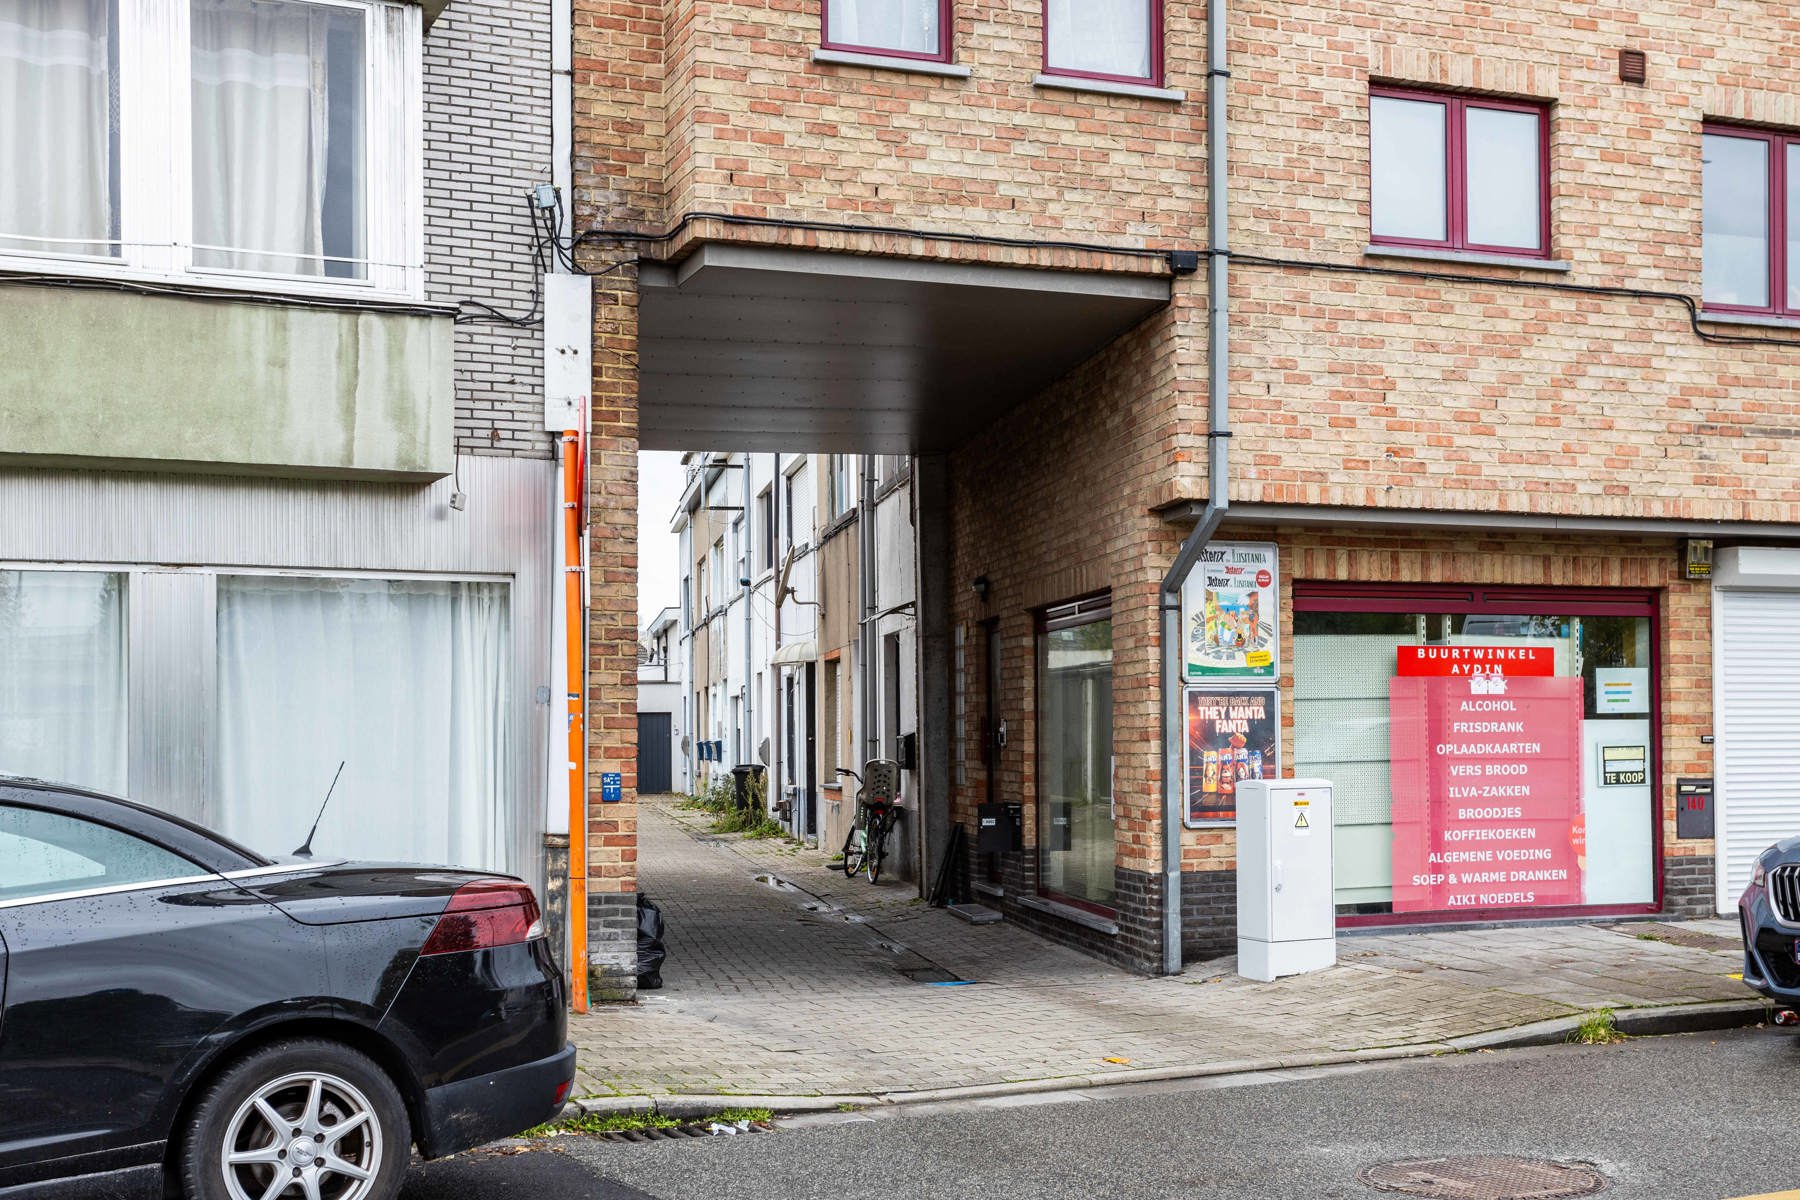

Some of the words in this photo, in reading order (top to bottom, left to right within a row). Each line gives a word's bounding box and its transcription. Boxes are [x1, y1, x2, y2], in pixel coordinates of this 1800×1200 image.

[1417, 648, 1536, 660] BUURTWINKEL
[1451, 664, 1503, 674] AYDIN
[1198, 706, 1228, 719] THEY
[1228, 706, 1266, 719] WANTA
[1460, 700, 1517, 712] ALCOHOL
[1215, 720, 1250, 733] FANTA
[1453, 721, 1524, 733] FRISDRANK
[1436, 742, 1541, 755] OPLAADKAARTEN
[1450, 764, 1482, 776] VERS
[1485, 764, 1528, 776] BROOD
[1605, 773, 1616, 783] TE
[1619, 772, 1645, 783] KOOP
[1449, 785, 1531, 798] ILVA-ZAKKEN
[1687, 796, 1705, 811] 140
[1458, 807, 1522, 819] BROODJES
[1444, 828, 1536, 841] KOFFIEKOEKEN
[1428, 850, 1493, 863] ALGEMENE
[1496, 848, 1552, 861] VOEDING
[1412, 873, 1445, 886] SOEP
[1448, 873, 1458, 884] &
[1460, 871, 1507, 883] WARME
[1510, 869, 1567, 882] DRANKEN
[1447, 894, 1476, 906] AIKI
[1479, 891, 1535, 905] NOEDELS
